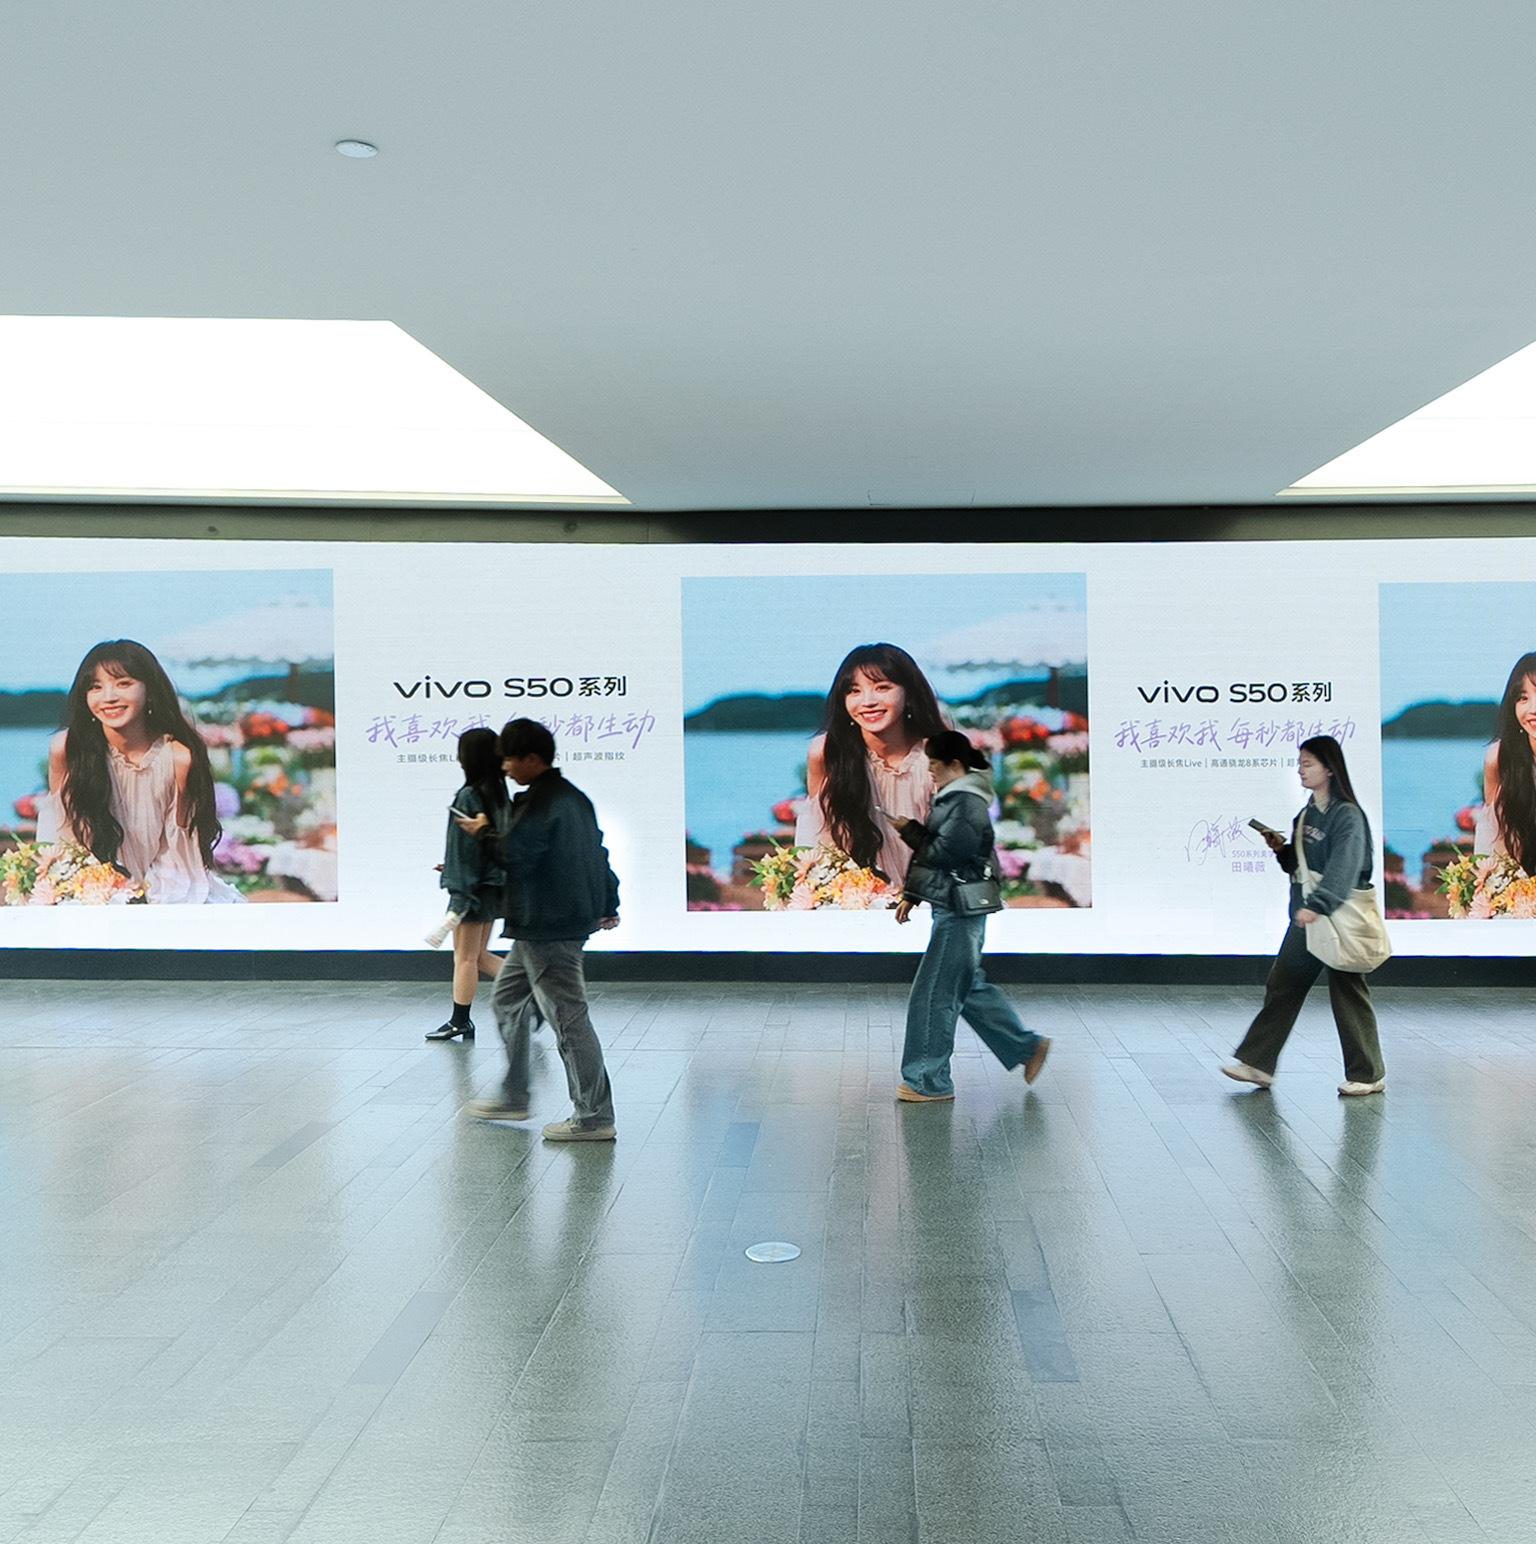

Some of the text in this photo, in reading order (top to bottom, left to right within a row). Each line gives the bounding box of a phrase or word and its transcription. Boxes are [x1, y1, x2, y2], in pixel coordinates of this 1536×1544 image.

[393, 675, 626, 698] vivo S50系列
[1137, 680, 1331, 703] vivo S50系列
[505, 710, 656, 749] 秒都生动
[1114, 719, 1222, 753] 我喜欢我
